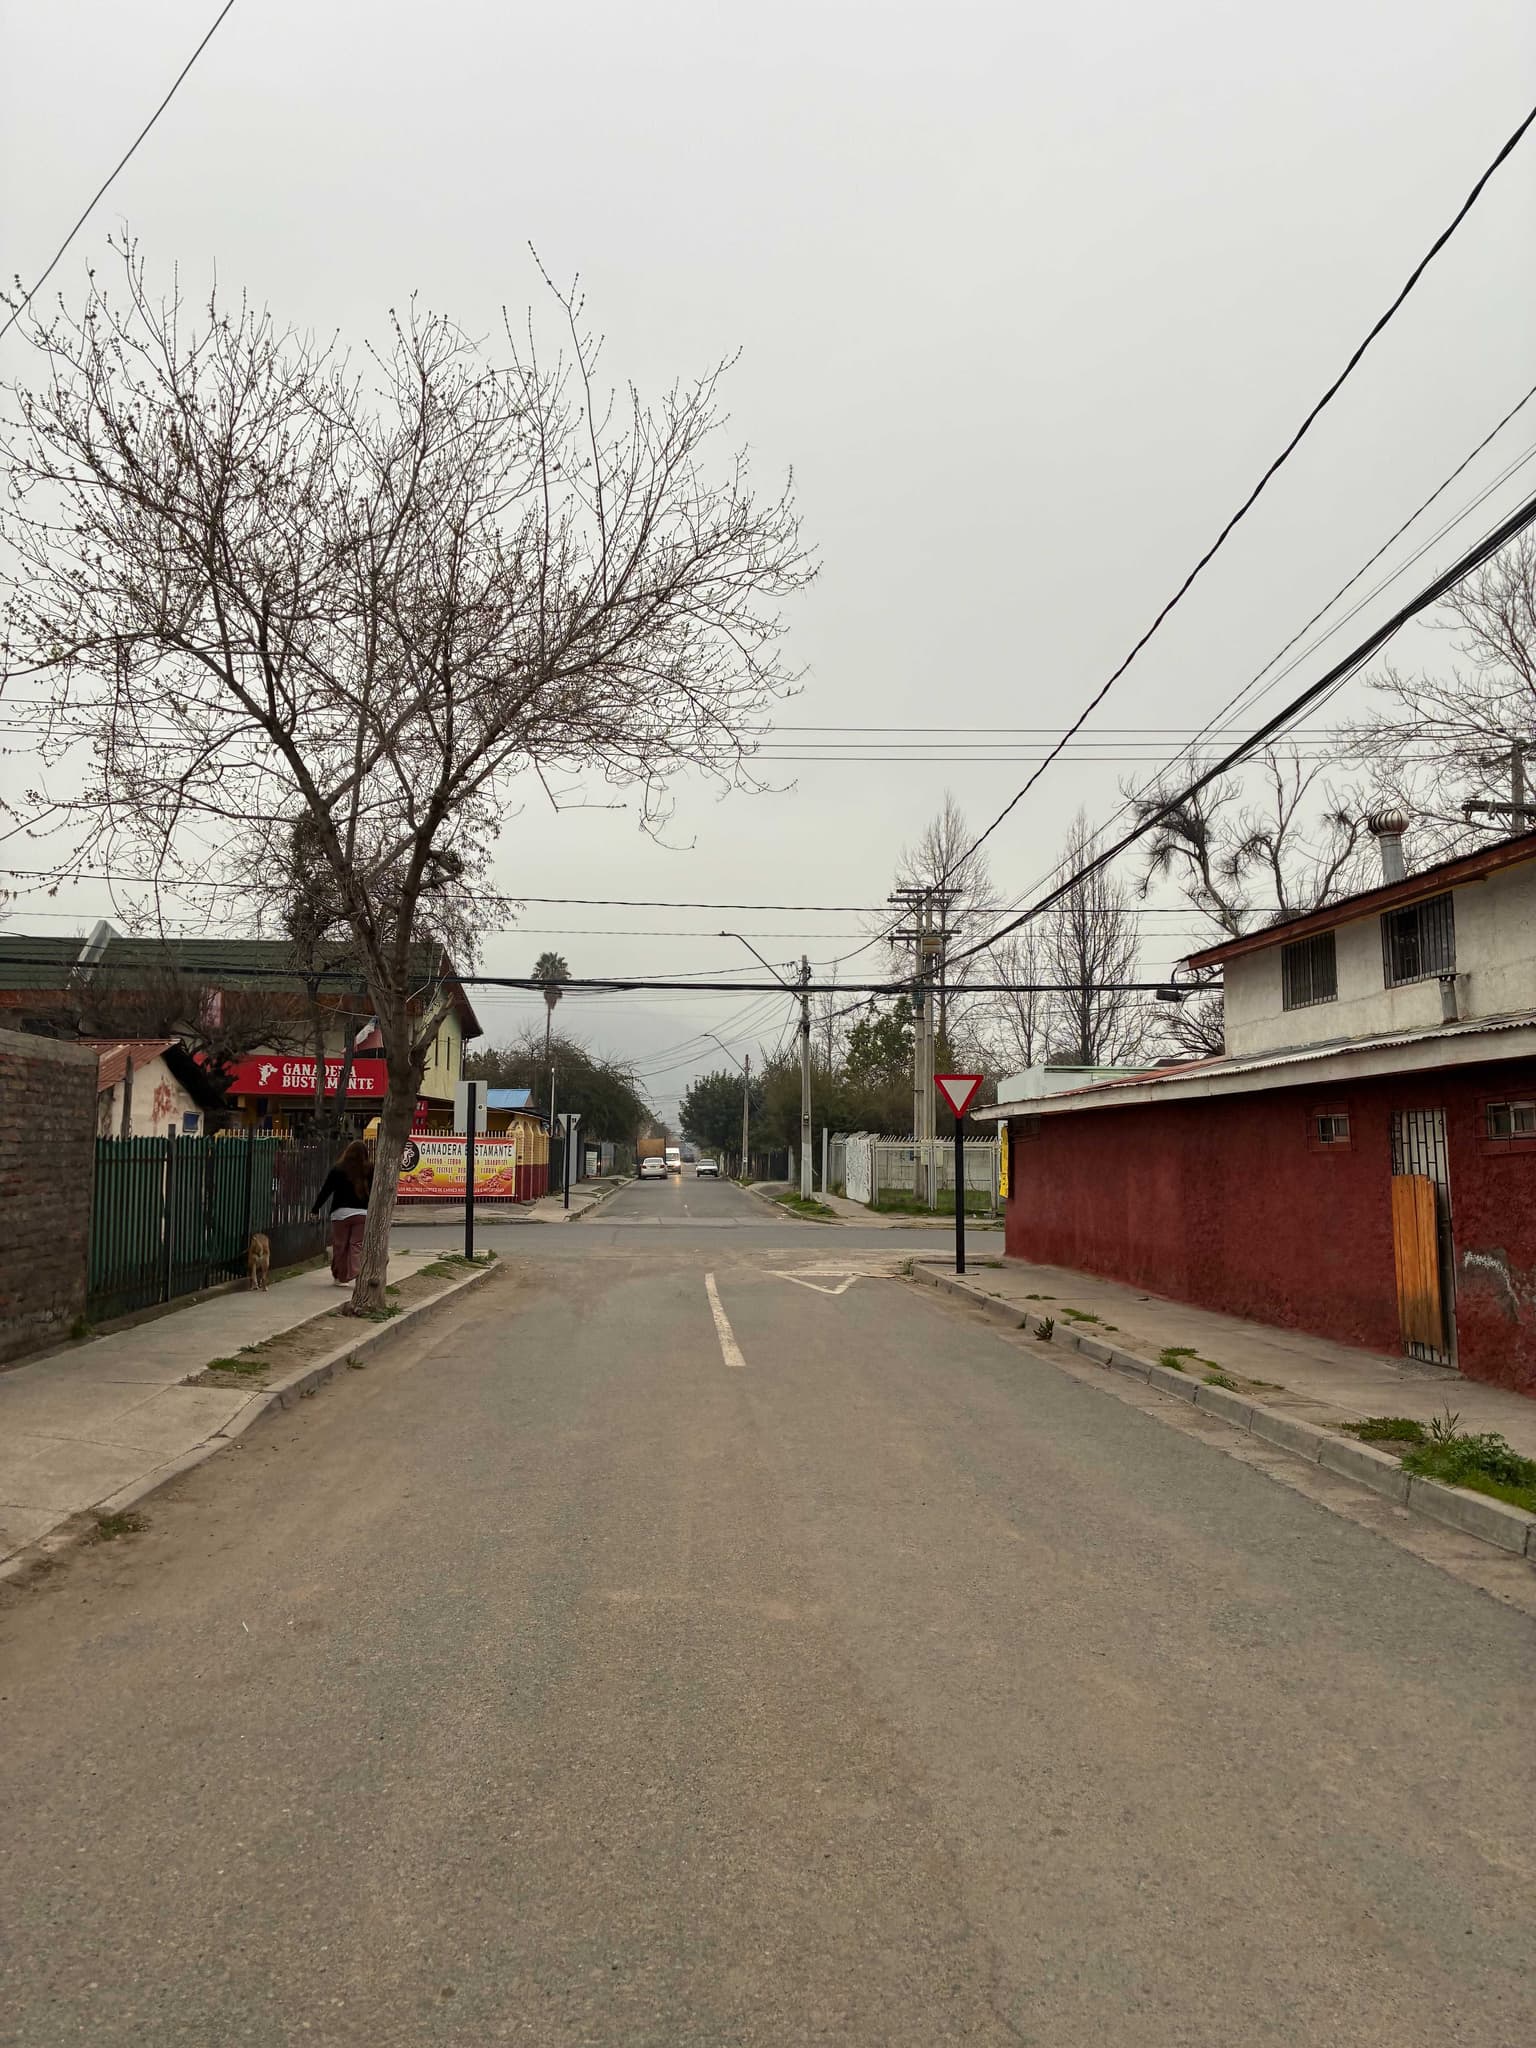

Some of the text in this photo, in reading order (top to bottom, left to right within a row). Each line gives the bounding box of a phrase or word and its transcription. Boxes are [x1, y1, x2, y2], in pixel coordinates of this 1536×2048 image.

[282, 1076, 374, 1090] BUSTMNTE
[420, 1143, 512, 1157] GANADERA BSTAMANTE
